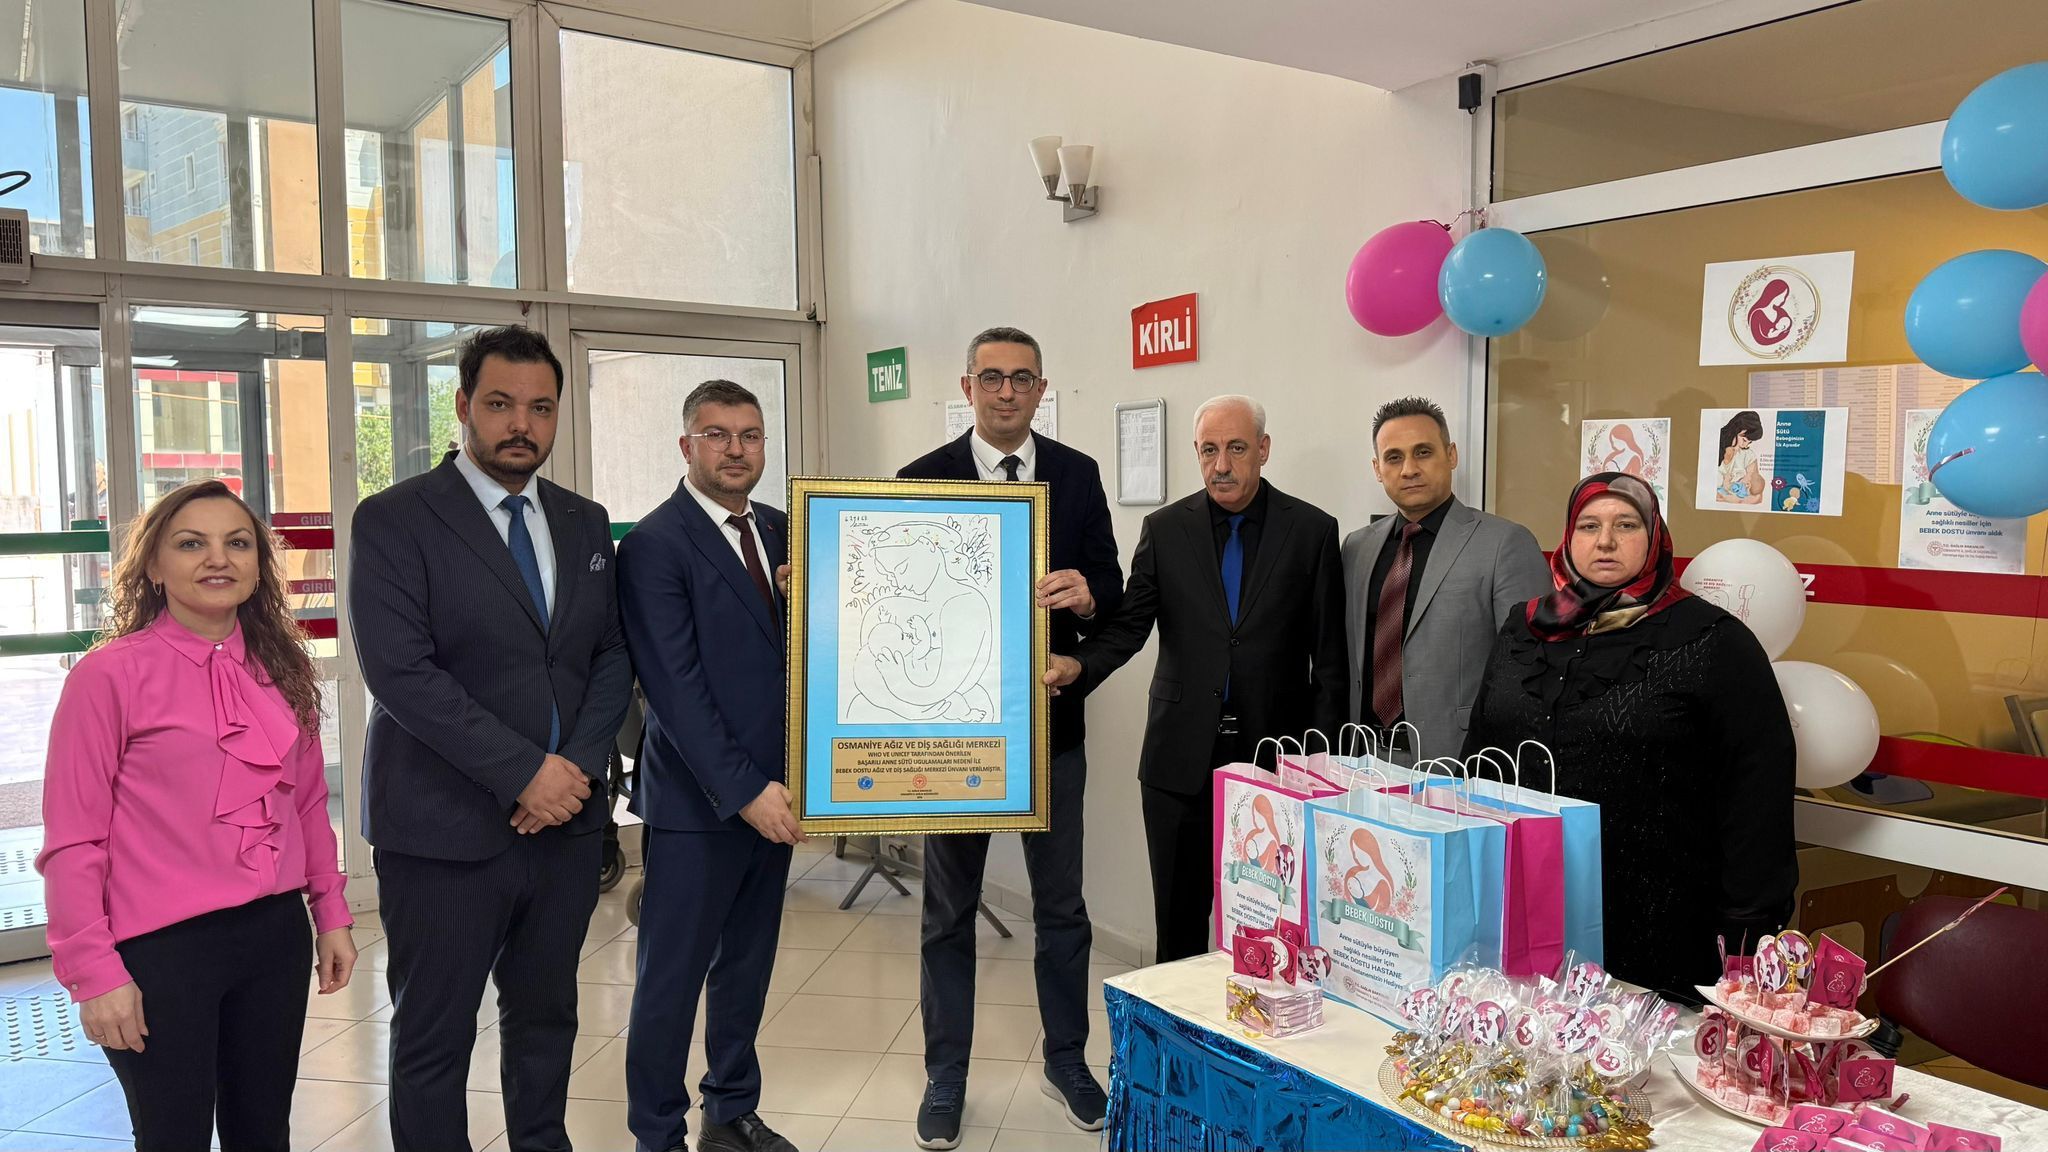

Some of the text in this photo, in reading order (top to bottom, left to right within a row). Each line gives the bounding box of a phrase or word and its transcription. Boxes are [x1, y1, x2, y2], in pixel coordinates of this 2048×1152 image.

[1139, 307, 1191, 356] KİRLİ
[872, 359, 902, 393] TEMİZ
[837, 739, 1001, 750] OSMANİYE AĞIZ VE DİŞ SAĞLIĞI MERKEZİ
[893, 766, 902, 774] DİŞ
[1242, 865, 1277, 888] BEBEK DOSTU
[1344, 904, 1394, 932] BEBEK DOSTU
[1339, 932, 1400, 958] Anne sütüyle büyüyen
[1333, 948, 1403, 980] BEBEK DOSTU HASTANE
[1361, 952, 1382, 964] nesiller
[1383, 958, 1395, 968] için
